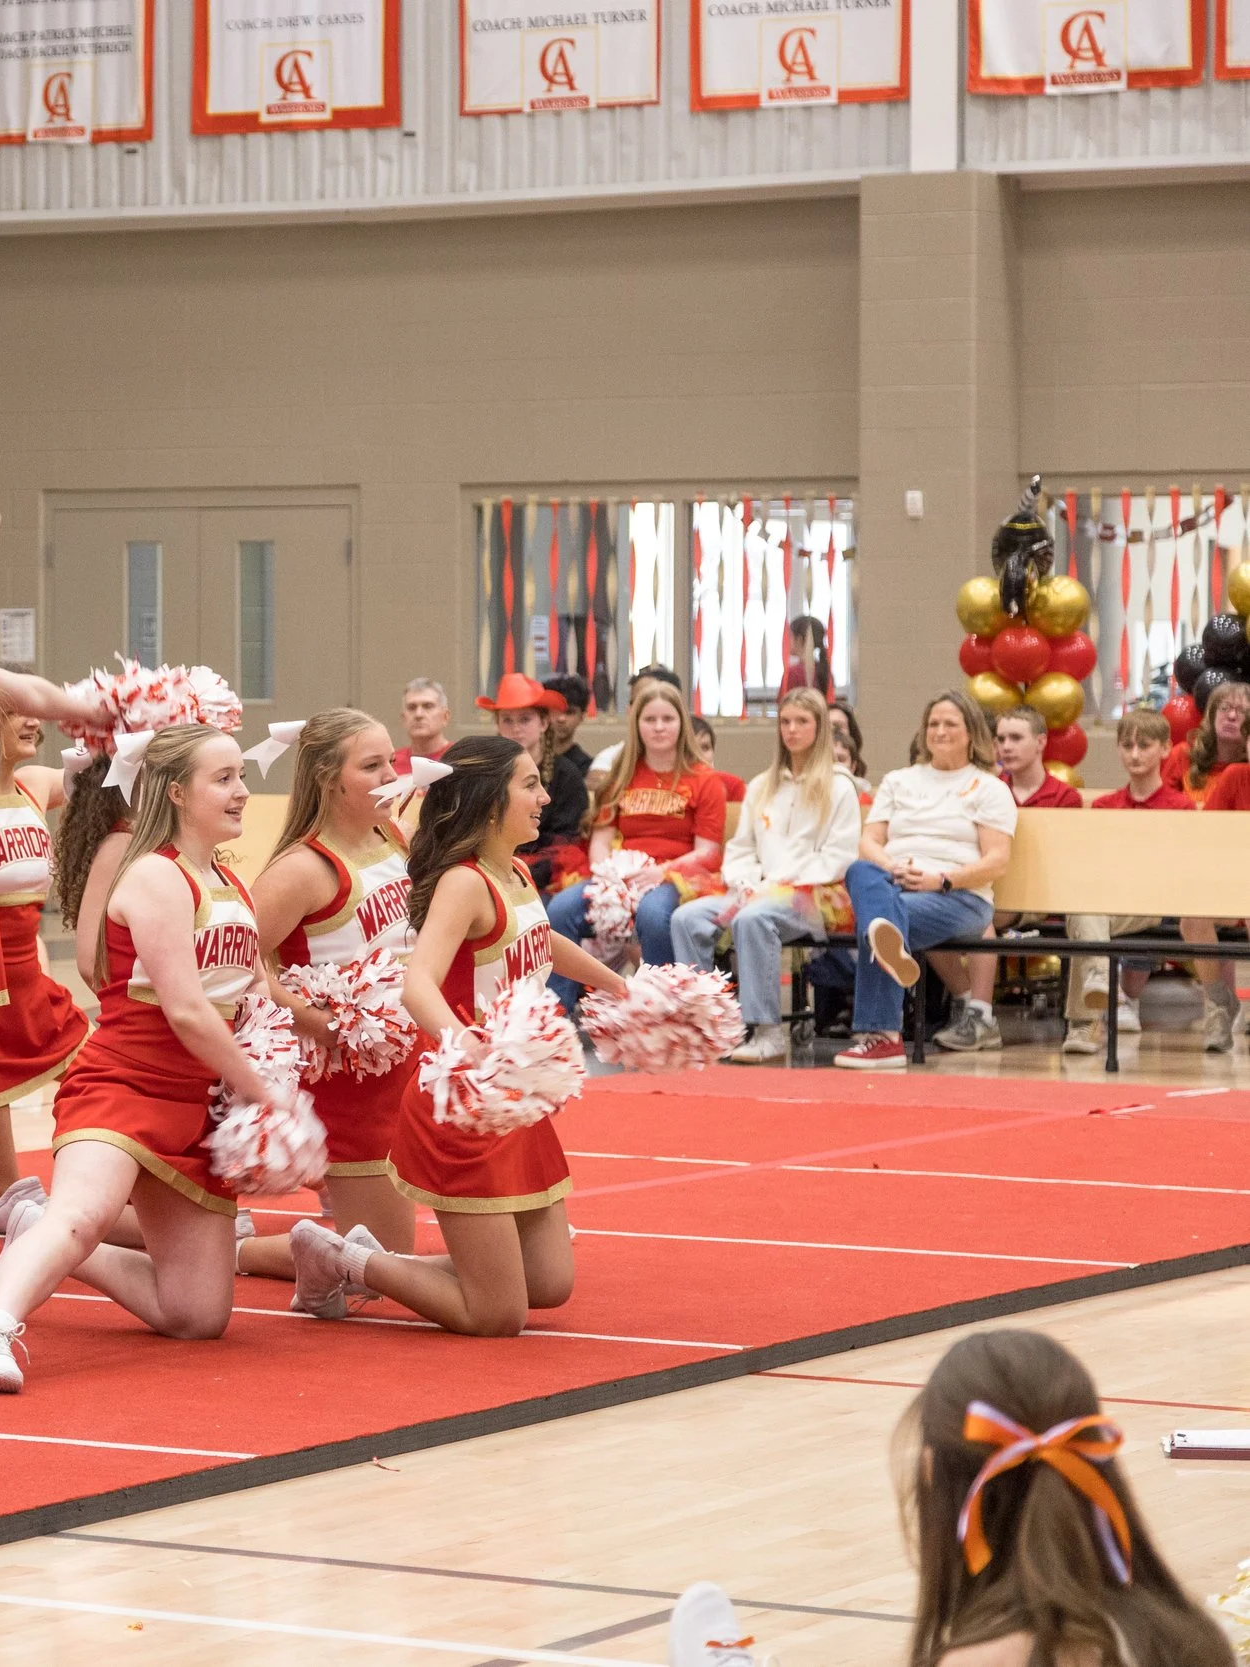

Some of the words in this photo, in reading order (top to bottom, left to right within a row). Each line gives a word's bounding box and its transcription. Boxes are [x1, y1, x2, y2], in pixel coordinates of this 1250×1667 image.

[766, 0, 829, 13] MICHAEL
[528, 13, 588, 28] MICHAEL
[593, 9, 647, 24] TURNER
